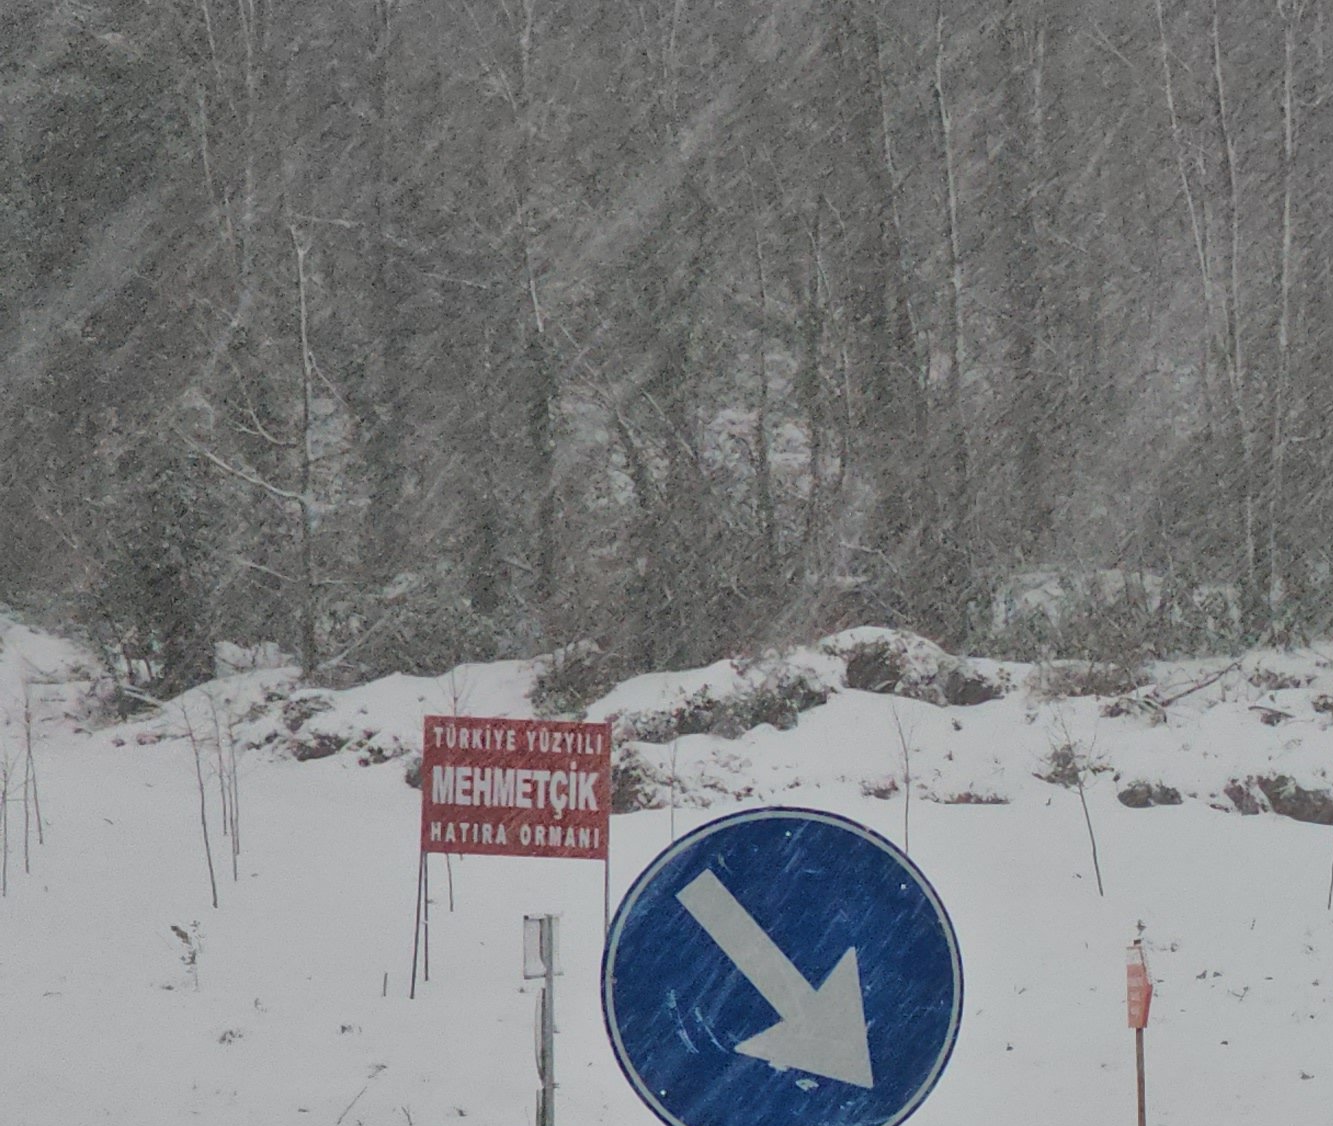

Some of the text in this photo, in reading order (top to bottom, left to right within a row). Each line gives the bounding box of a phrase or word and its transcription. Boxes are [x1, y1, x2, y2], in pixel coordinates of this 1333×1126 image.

[433, 724, 602, 755] TÜRKİYE YÜZYILI
[432, 761, 599, 820] MEHMETÇİK
[430, 821, 599, 849] HATIRA ORMANI
